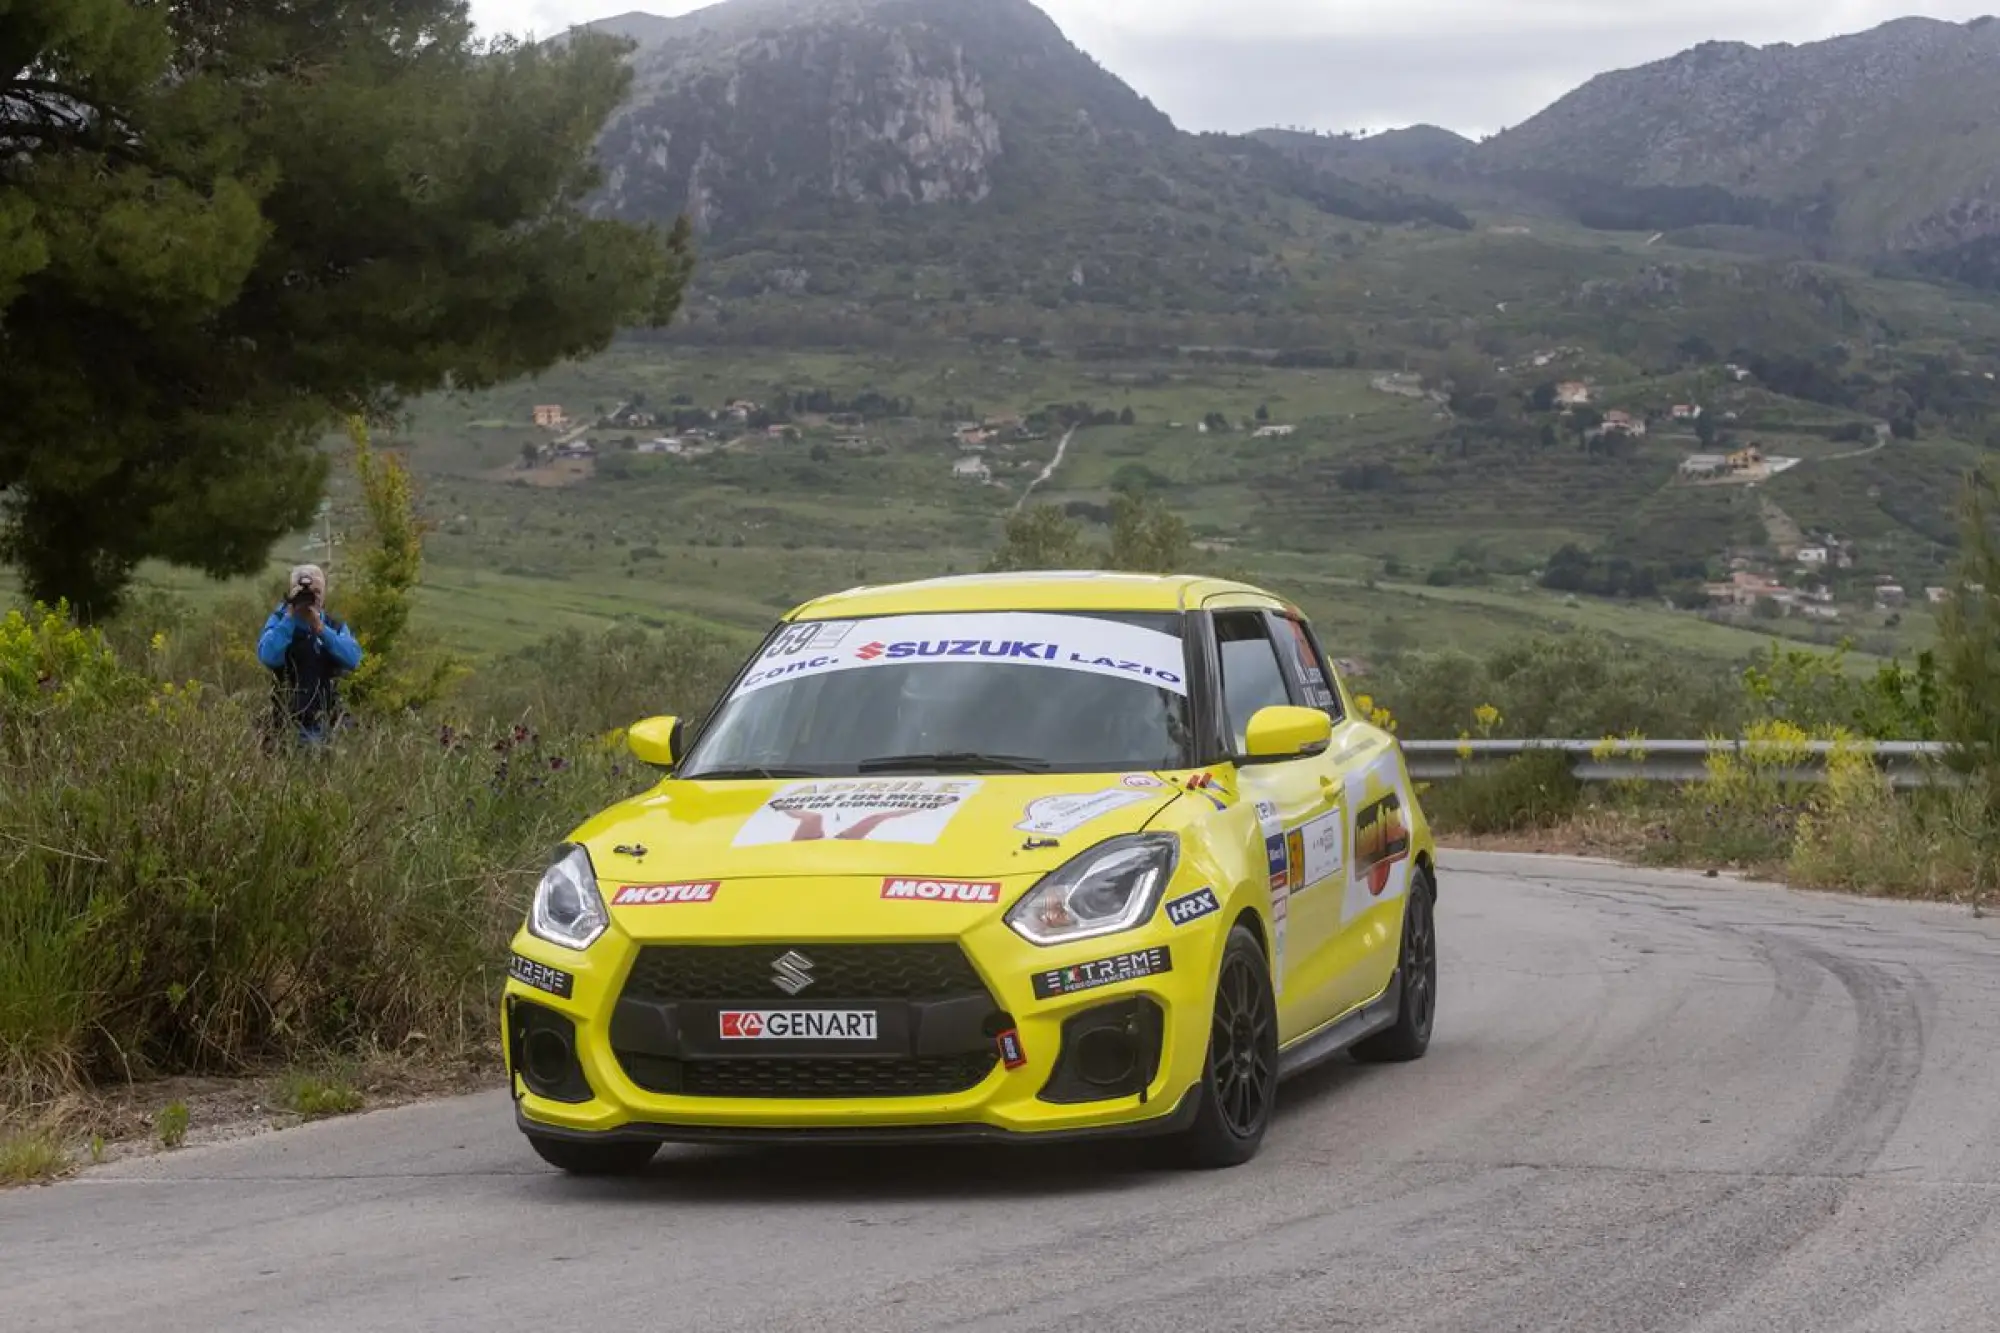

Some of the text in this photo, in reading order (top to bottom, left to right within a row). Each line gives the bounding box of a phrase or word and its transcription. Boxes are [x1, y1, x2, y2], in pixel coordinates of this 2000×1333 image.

[766, 622, 823, 659] 59
[884, 640, 1058, 660] SUZUKI
[1070, 652, 1181, 684] LAZIO
[615, 884, 712, 903] MOTUL
[885, 880, 994, 900] MOTUL
[1172, 892, 1212, 922] HRX
[1046, 950, 1160, 989] EXTREME
[767, 1012, 874, 1036] GENART
